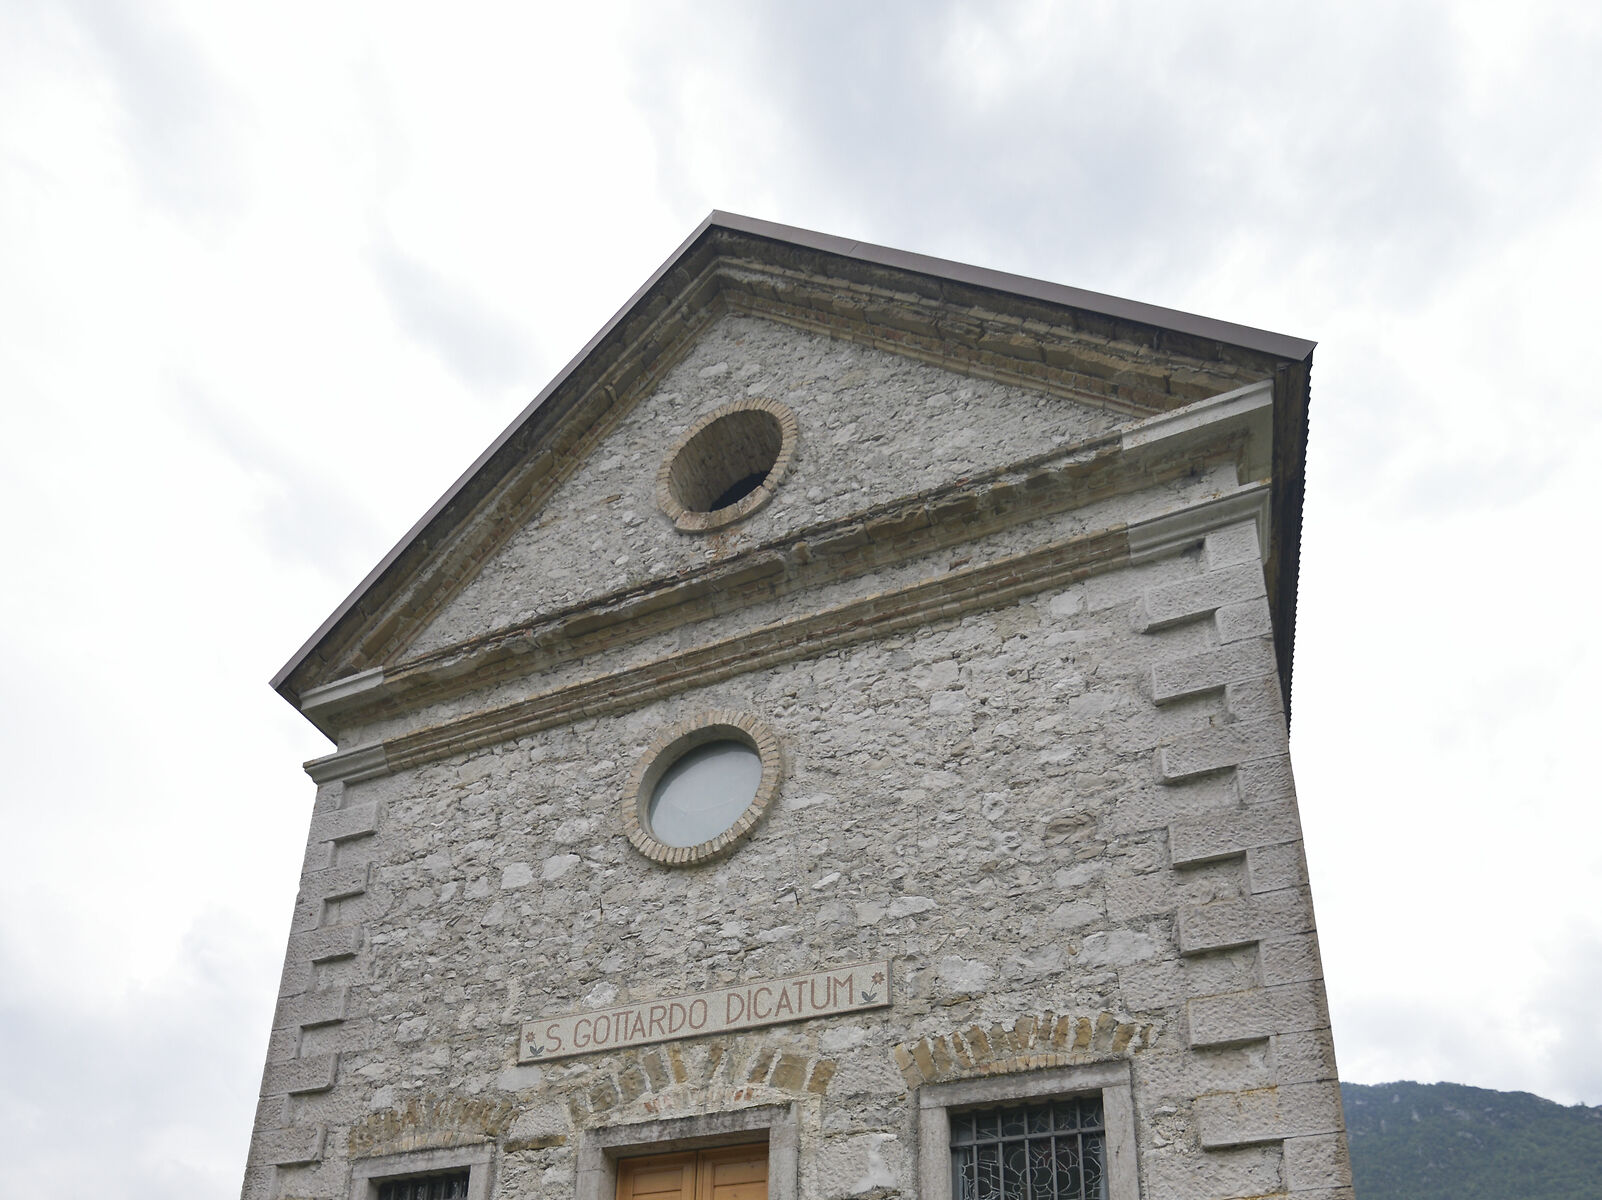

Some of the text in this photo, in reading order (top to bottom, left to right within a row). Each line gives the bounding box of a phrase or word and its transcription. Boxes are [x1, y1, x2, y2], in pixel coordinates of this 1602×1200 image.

[545, 975, 854, 1052] S. GOTTARDO DICATUM
